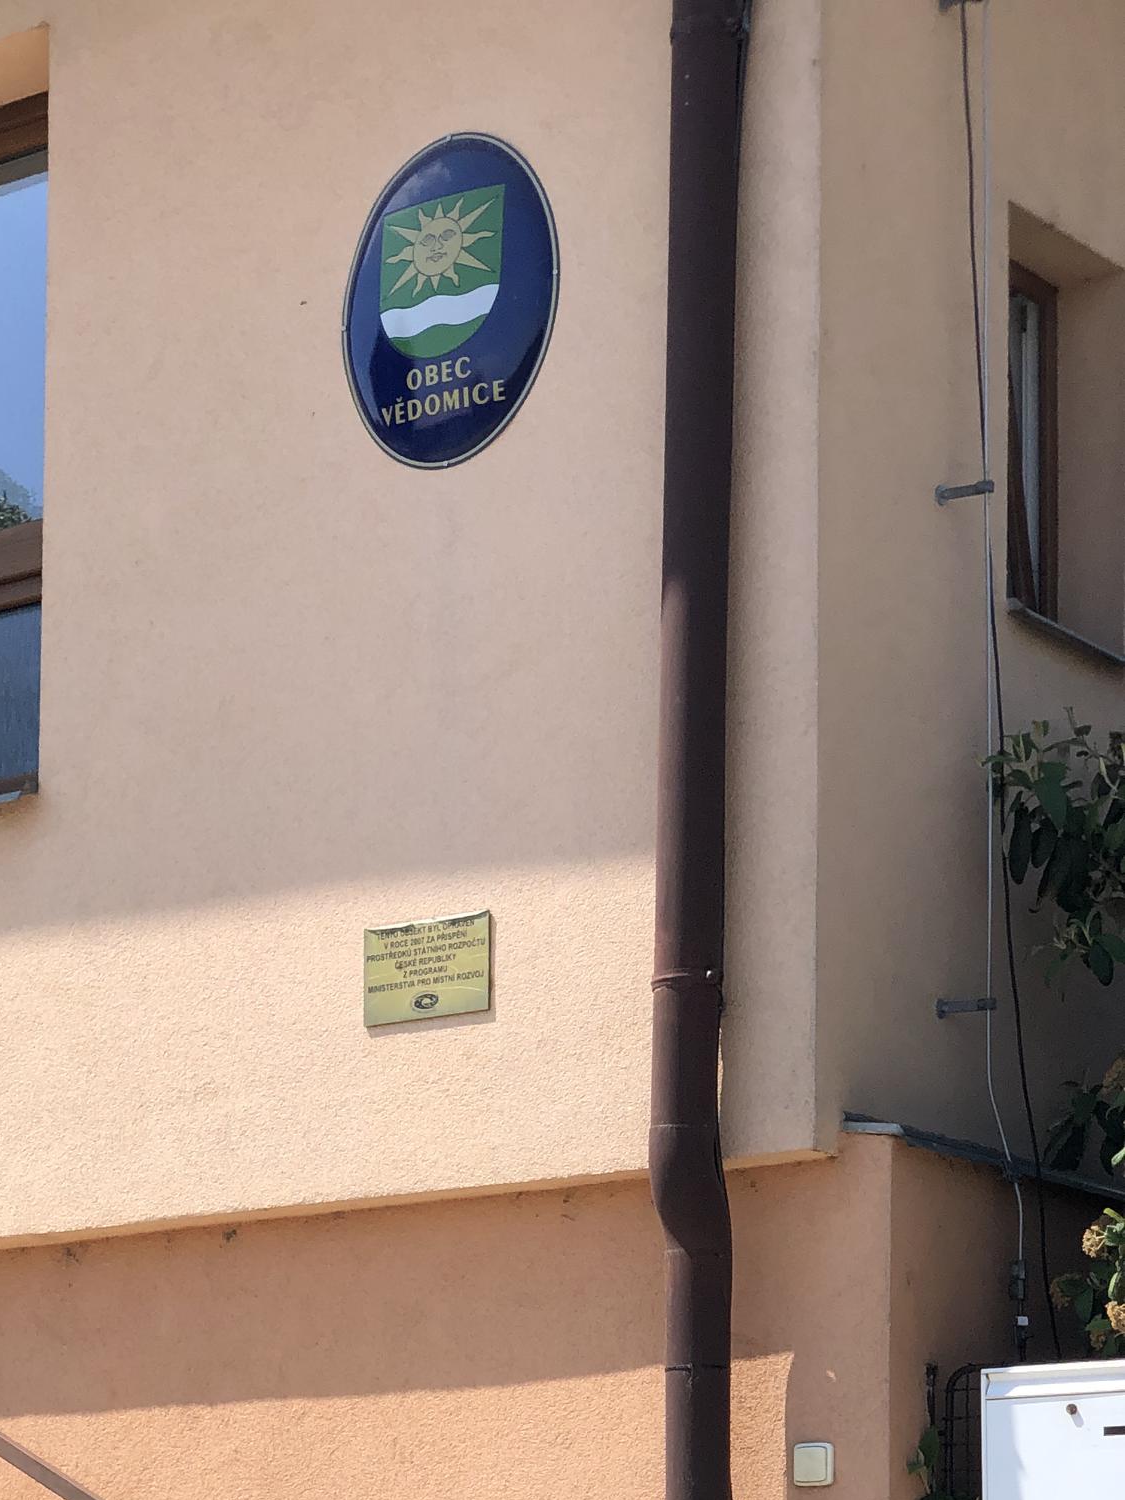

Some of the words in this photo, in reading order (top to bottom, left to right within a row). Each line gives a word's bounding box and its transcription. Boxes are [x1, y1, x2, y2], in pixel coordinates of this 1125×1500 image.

[406, 356, 472, 391] OBEC
[381, 379, 506, 428] VĚDOMICE
[427, 923, 441, 933] BYL
[389, 938, 409, 949] ROCE
[426, 934, 436, 944] ZA
[448, 935, 486, 951] ROZPOČTU
[394, 957, 418, 970] ČESKÉ
[419, 952, 457, 967] REPUBLIKY
[402, 970, 408, 979] Z
[409, 965, 448, 977] PROGRAMU
[367, 980, 416, 994] MINISTERSTVA
[417, 976, 432, 987] PRO
[456, 969, 485, 981] ROZVOJ
